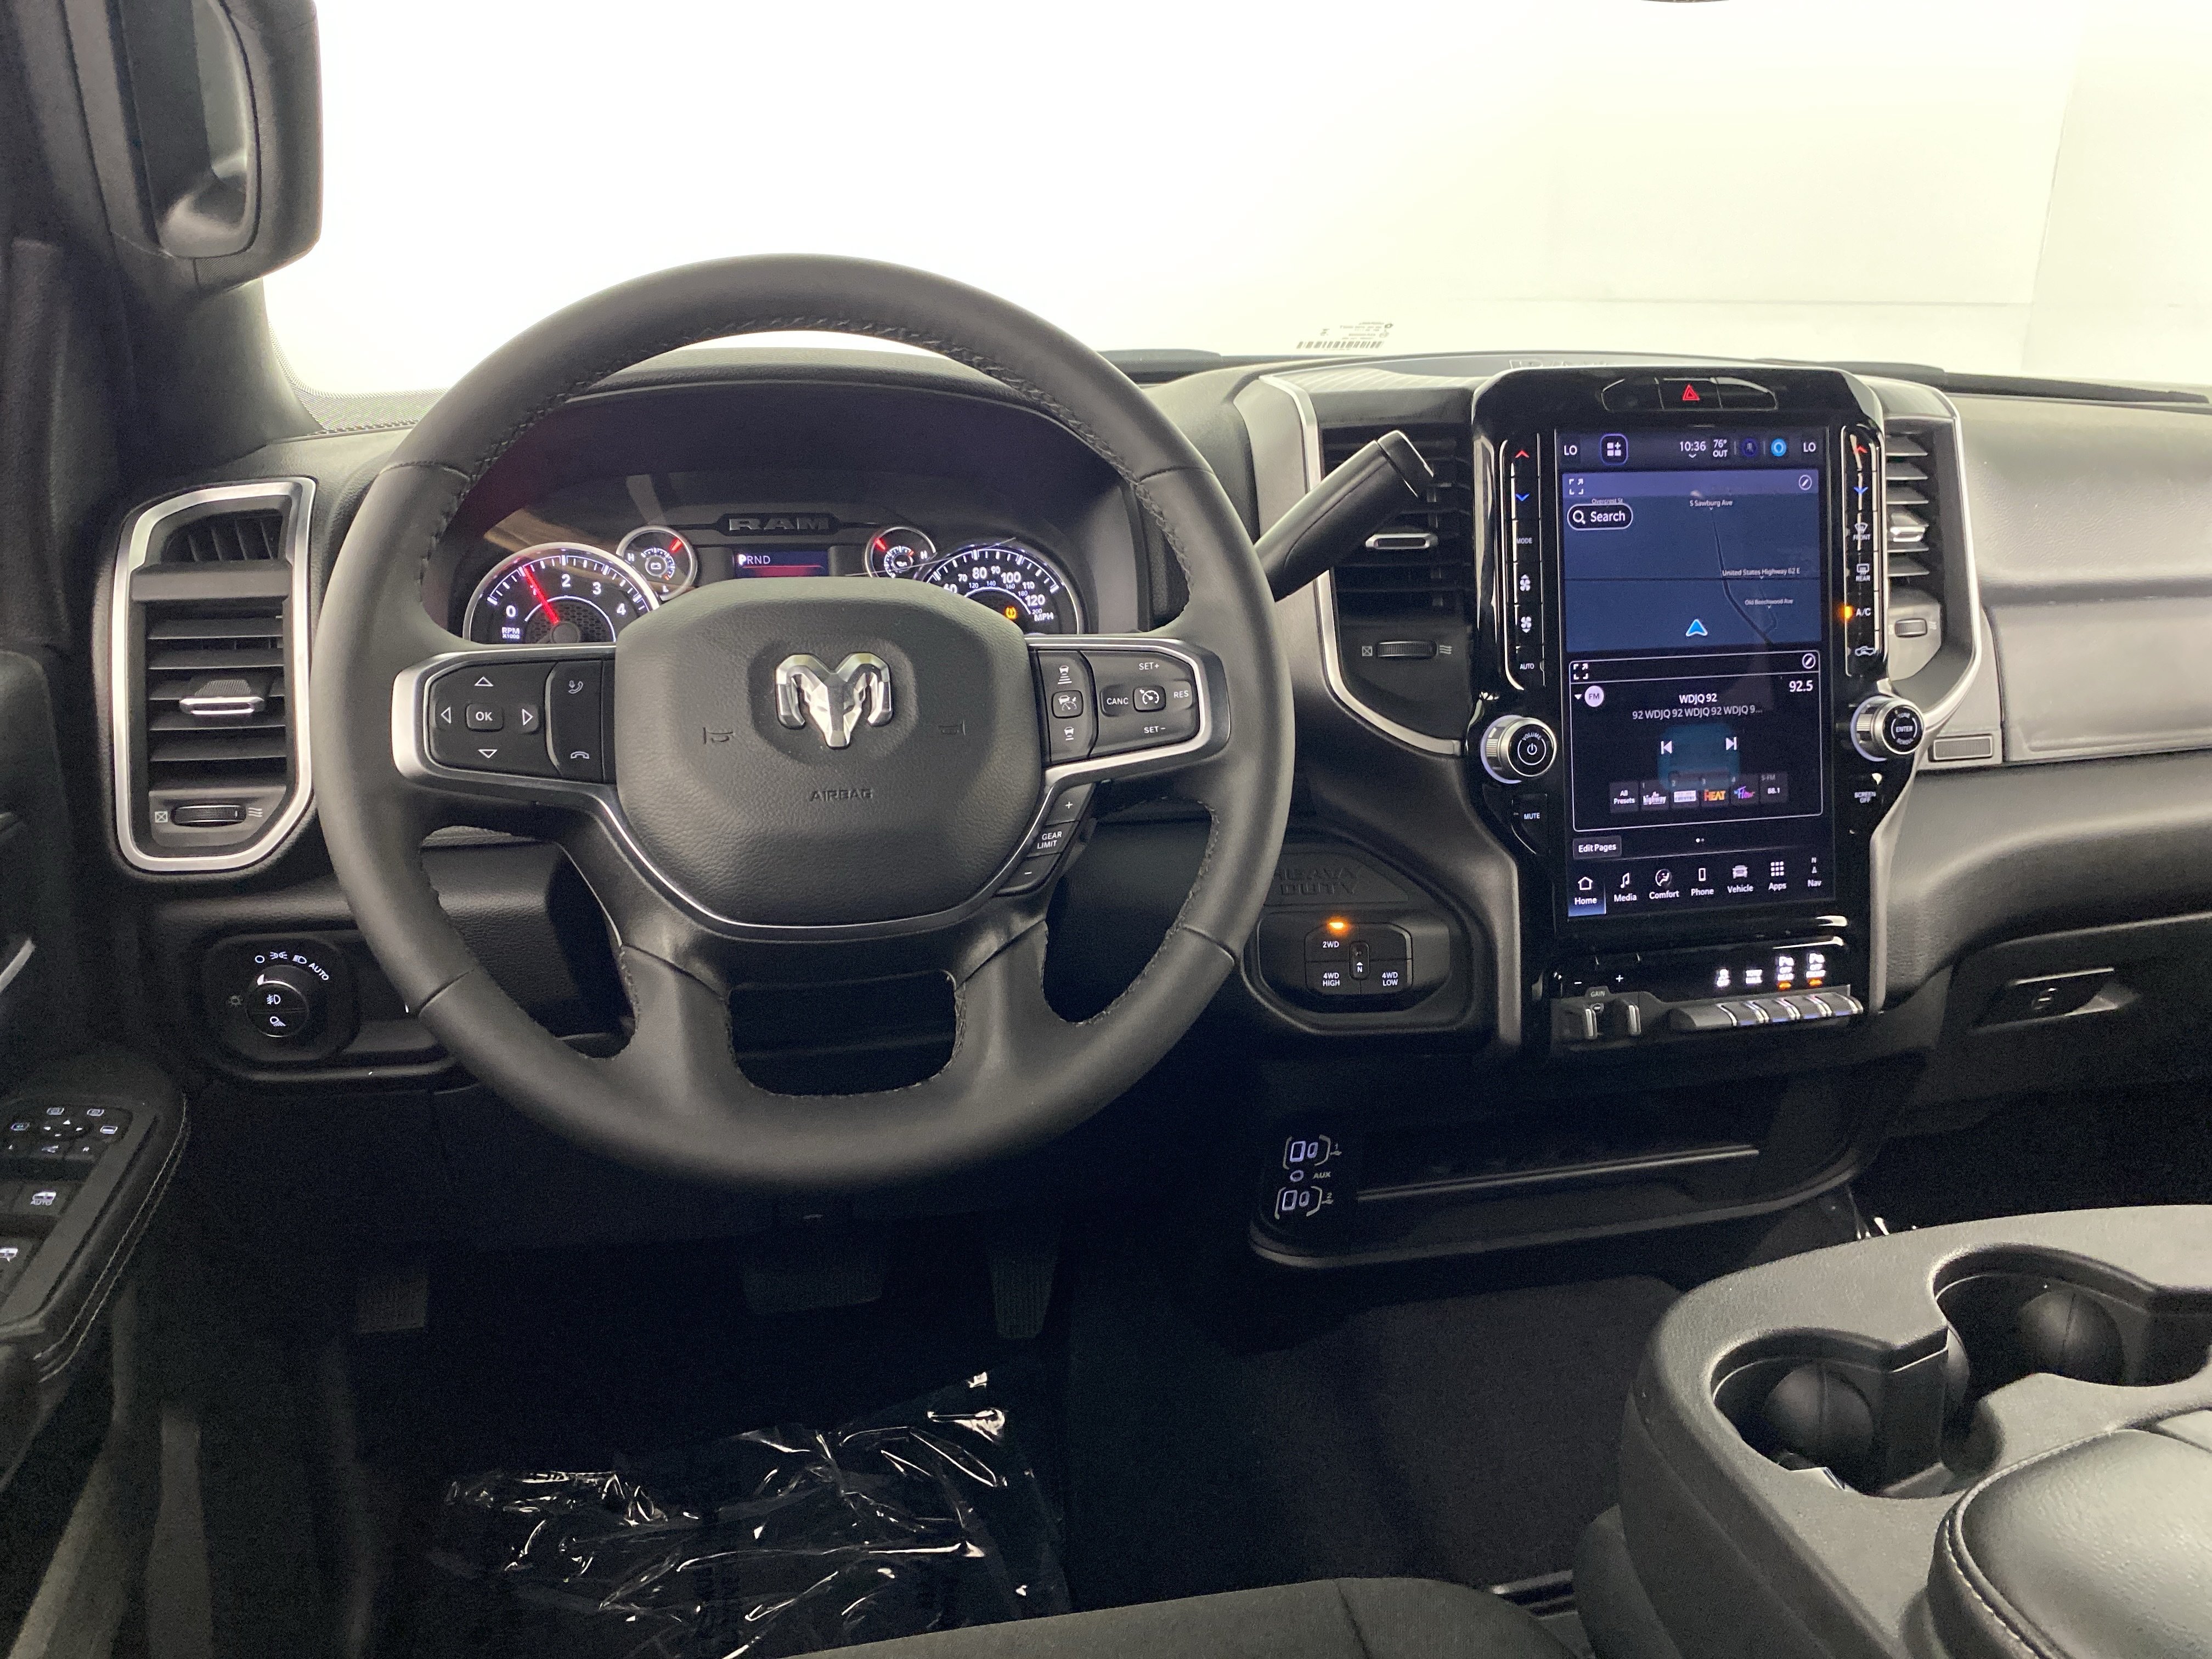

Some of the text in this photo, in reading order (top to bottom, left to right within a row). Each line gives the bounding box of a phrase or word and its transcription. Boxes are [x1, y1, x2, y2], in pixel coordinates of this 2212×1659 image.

[1679, 441, 1707, 452] 10:36
[1713, 439, 1728, 448] 76°
[1803, 442, 1816, 453] LO
[1564, 445, 1578, 456] LO
[1712, 449, 1728, 458] OUT
[1590, 511, 1626, 522] Search
[729, 517, 830, 531] RAM
[972, 567, 987, 579] 80
[991, 566, 1001, 574] 90
[561, 573, 571, 588] 2
[958, 574, 968, 582] 70
[1001, 572, 1021, 584] 100
[592, 582, 602, 595] 3
[1025, 594, 1046, 607] 120
[505, 605, 516, 618] 0
[616, 603, 627, 616] 4
[1855, 608, 1871, 616] A/C
[1034, 612, 1054, 622] MPH
[1788, 679, 1814, 692] 92.5
[1173, 690, 1189, 699] RES
[1679, 693, 1718, 705] WDJQ 92
[1106, 697, 1129, 706] CANC
[475, 711, 493, 721] OK
[1632, 710, 1644, 720] 92
[1645, 709, 1671, 720] WDJQ
[1672, 708, 1683, 718] 92
[1684, 707, 1710, 718] WDJQ
[1711, 707, 1722, 715] 92
[1723, 706, 1748, 716] WDJQ
[1521, 732, 1542, 741] VOLUME
[809, 788, 873, 802] AIRBAG
[1042, 831, 1063, 840] GEAR
[1037, 840, 1058, 849] LIMIT
[1578, 843, 1617, 853] Edit Pages
[1768, 882, 1787, 891] Apps
[1807, 879, 1822, 887] Nav
[1691, 888, 1714, 896] Phone
[1727, 884, 1754, 894] Vehicle
[1613, 893, 1637, 902] Media
[1649, 890, 1680, 900] Comfort
[1575, 896, 1597, 905] Home
[308, 962, 329, 981] AUTO
[1312, 1171, 1331, 1180] AUX
